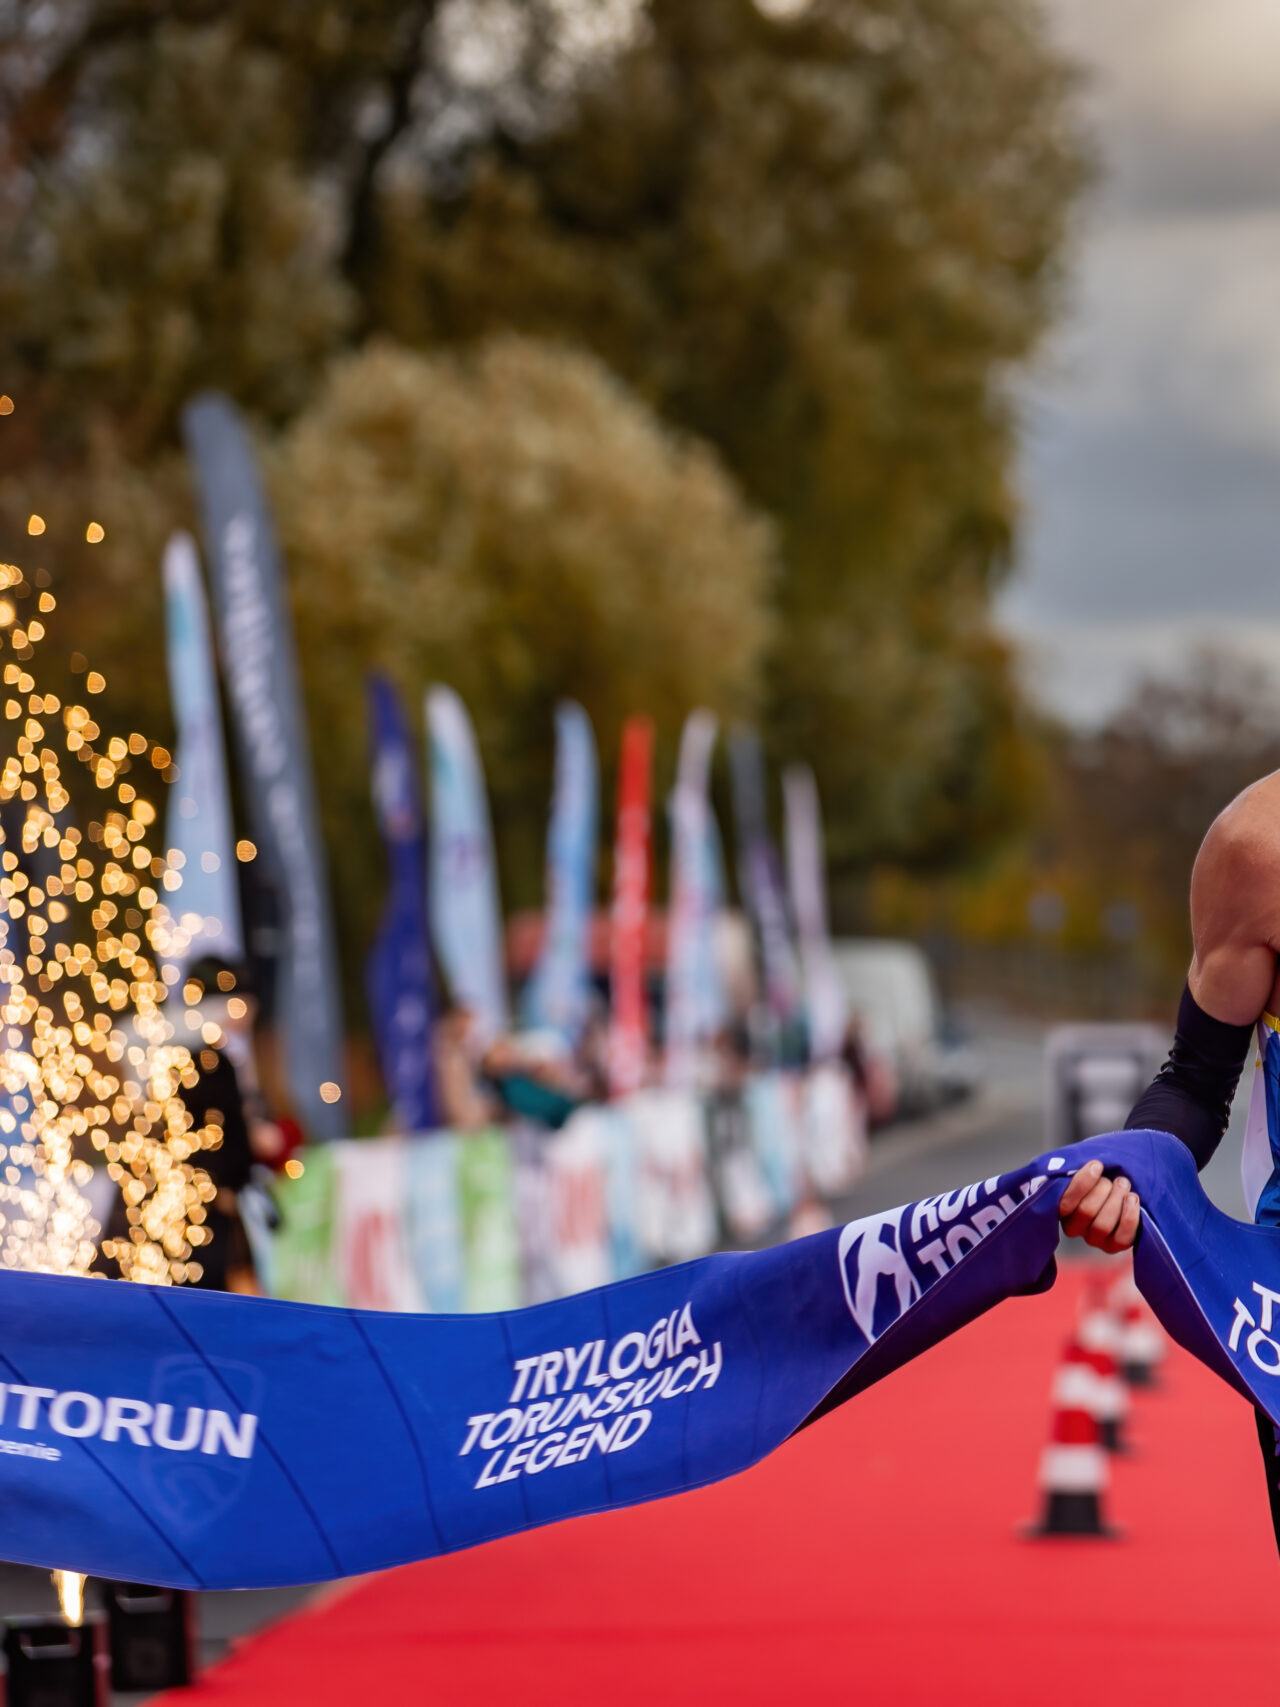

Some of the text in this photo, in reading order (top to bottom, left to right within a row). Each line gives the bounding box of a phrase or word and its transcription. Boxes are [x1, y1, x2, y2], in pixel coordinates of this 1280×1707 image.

[509, 1301, 702, 1403] TRYLOGIA
[0, 1381, 259, 1459] TORUN
[474, 1409, 652, 1490] LEGEND
